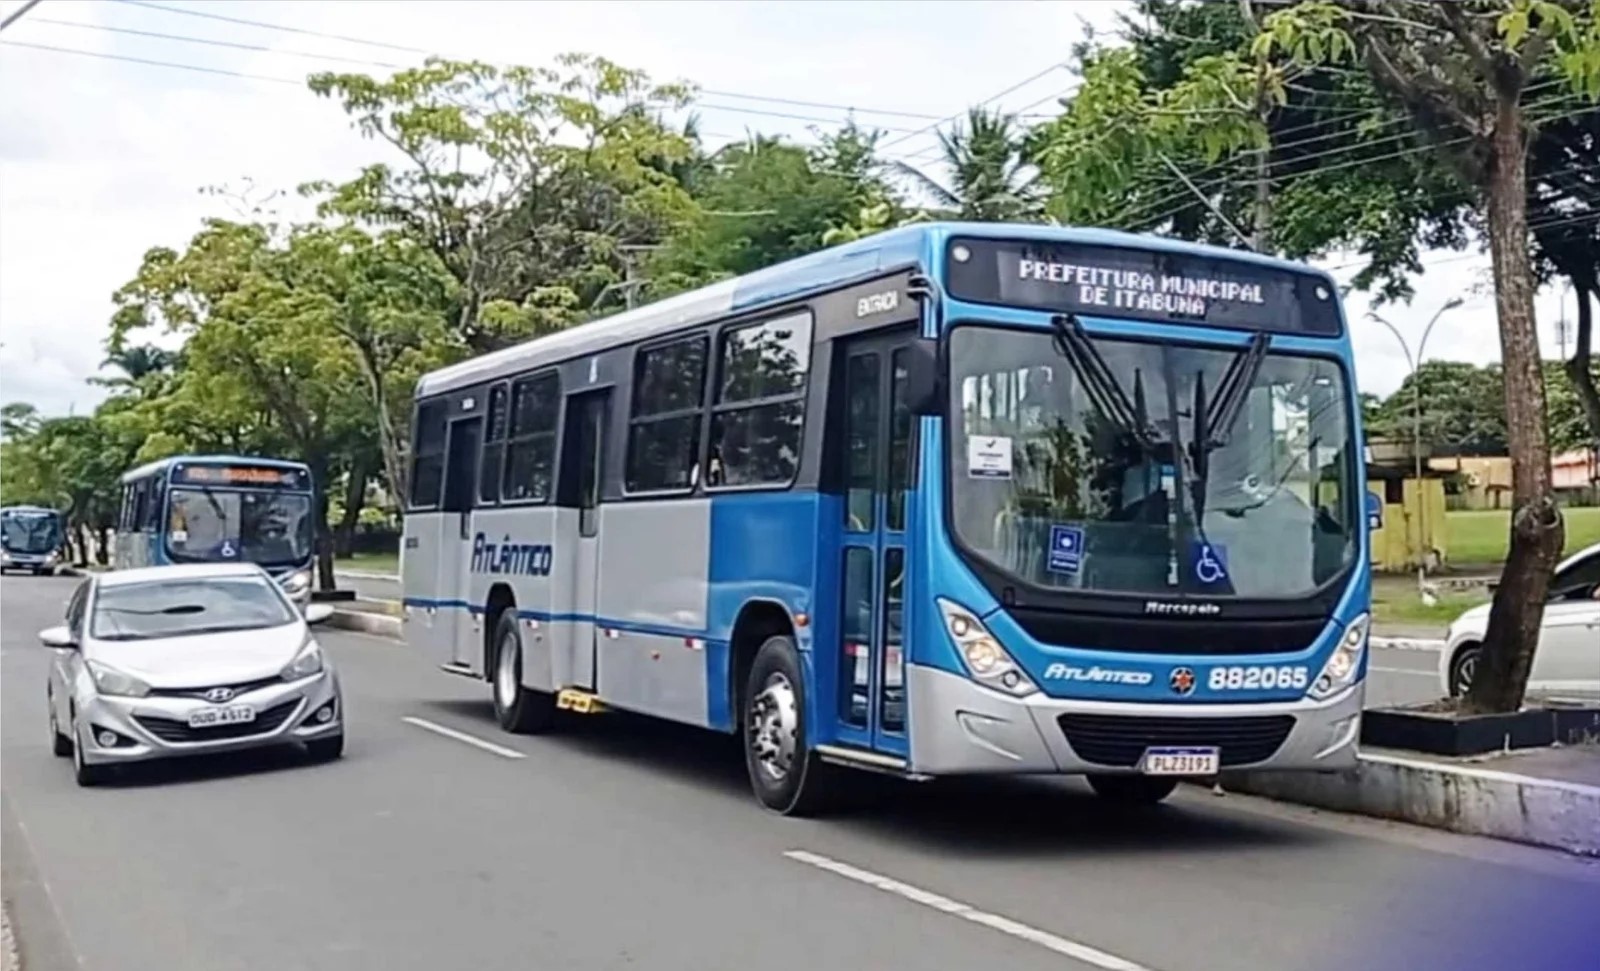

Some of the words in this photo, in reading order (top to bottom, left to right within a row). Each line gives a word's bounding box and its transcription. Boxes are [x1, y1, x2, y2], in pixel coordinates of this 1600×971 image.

[1019, 260, 1154, 291] PREFEITURA
[1161, 275, 1264, 303] MUNICIPAL
[1079, 286, 1108, 305] DE
[1114, 290, 1206, 315] ITABUNA
[1208, 666, 1307, 689] 882065
